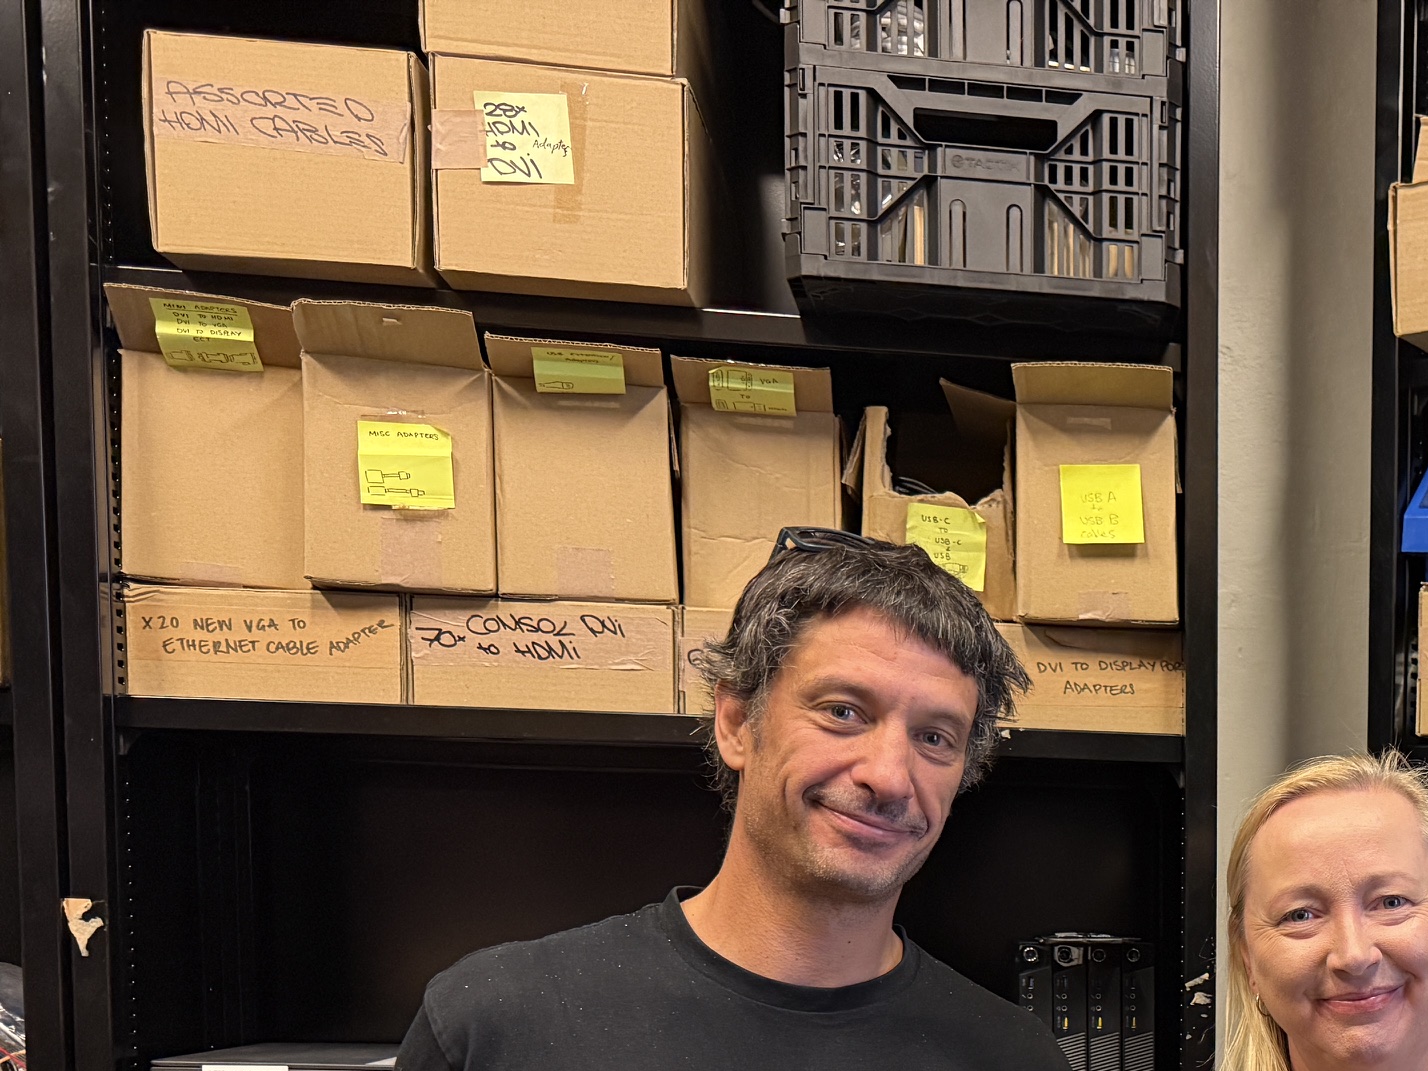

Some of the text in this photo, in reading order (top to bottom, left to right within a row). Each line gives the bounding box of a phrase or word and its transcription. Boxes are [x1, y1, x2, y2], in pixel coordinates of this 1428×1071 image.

[165, 81, 374, 122] ASSORTED
[159, 109, 387, 156] HDMI CABLES
[485, 120, 540, 137] HDMI
[210, 329, 242, 337] DISPLAY
[397, 431, 439, 441] ADAPTERS
[1080, 491, 1117, 504] USB A
[921, 514, 951, 525] USB-C
[1079, 513, 1119, 525] USB B
[935, 537, 962, 546] USB-C
[934, 552, 951, 561] USB
[193, 617, 233, 633] NEW
[243, 618, 279, 633] VGA
[288, 618, 307, 630] TO
[466, 614, 575, 637] COMSOL
[162, 618, 394, 656] ETHERNET CABLE ADAPTER
[1036, 661, 1063, 674] DVI
[1072, 661, 1090, 671] TO
[1098, 660, 1156, 671] DISPLAY
[1064, 680, 1136, 696] ADAPTERS
